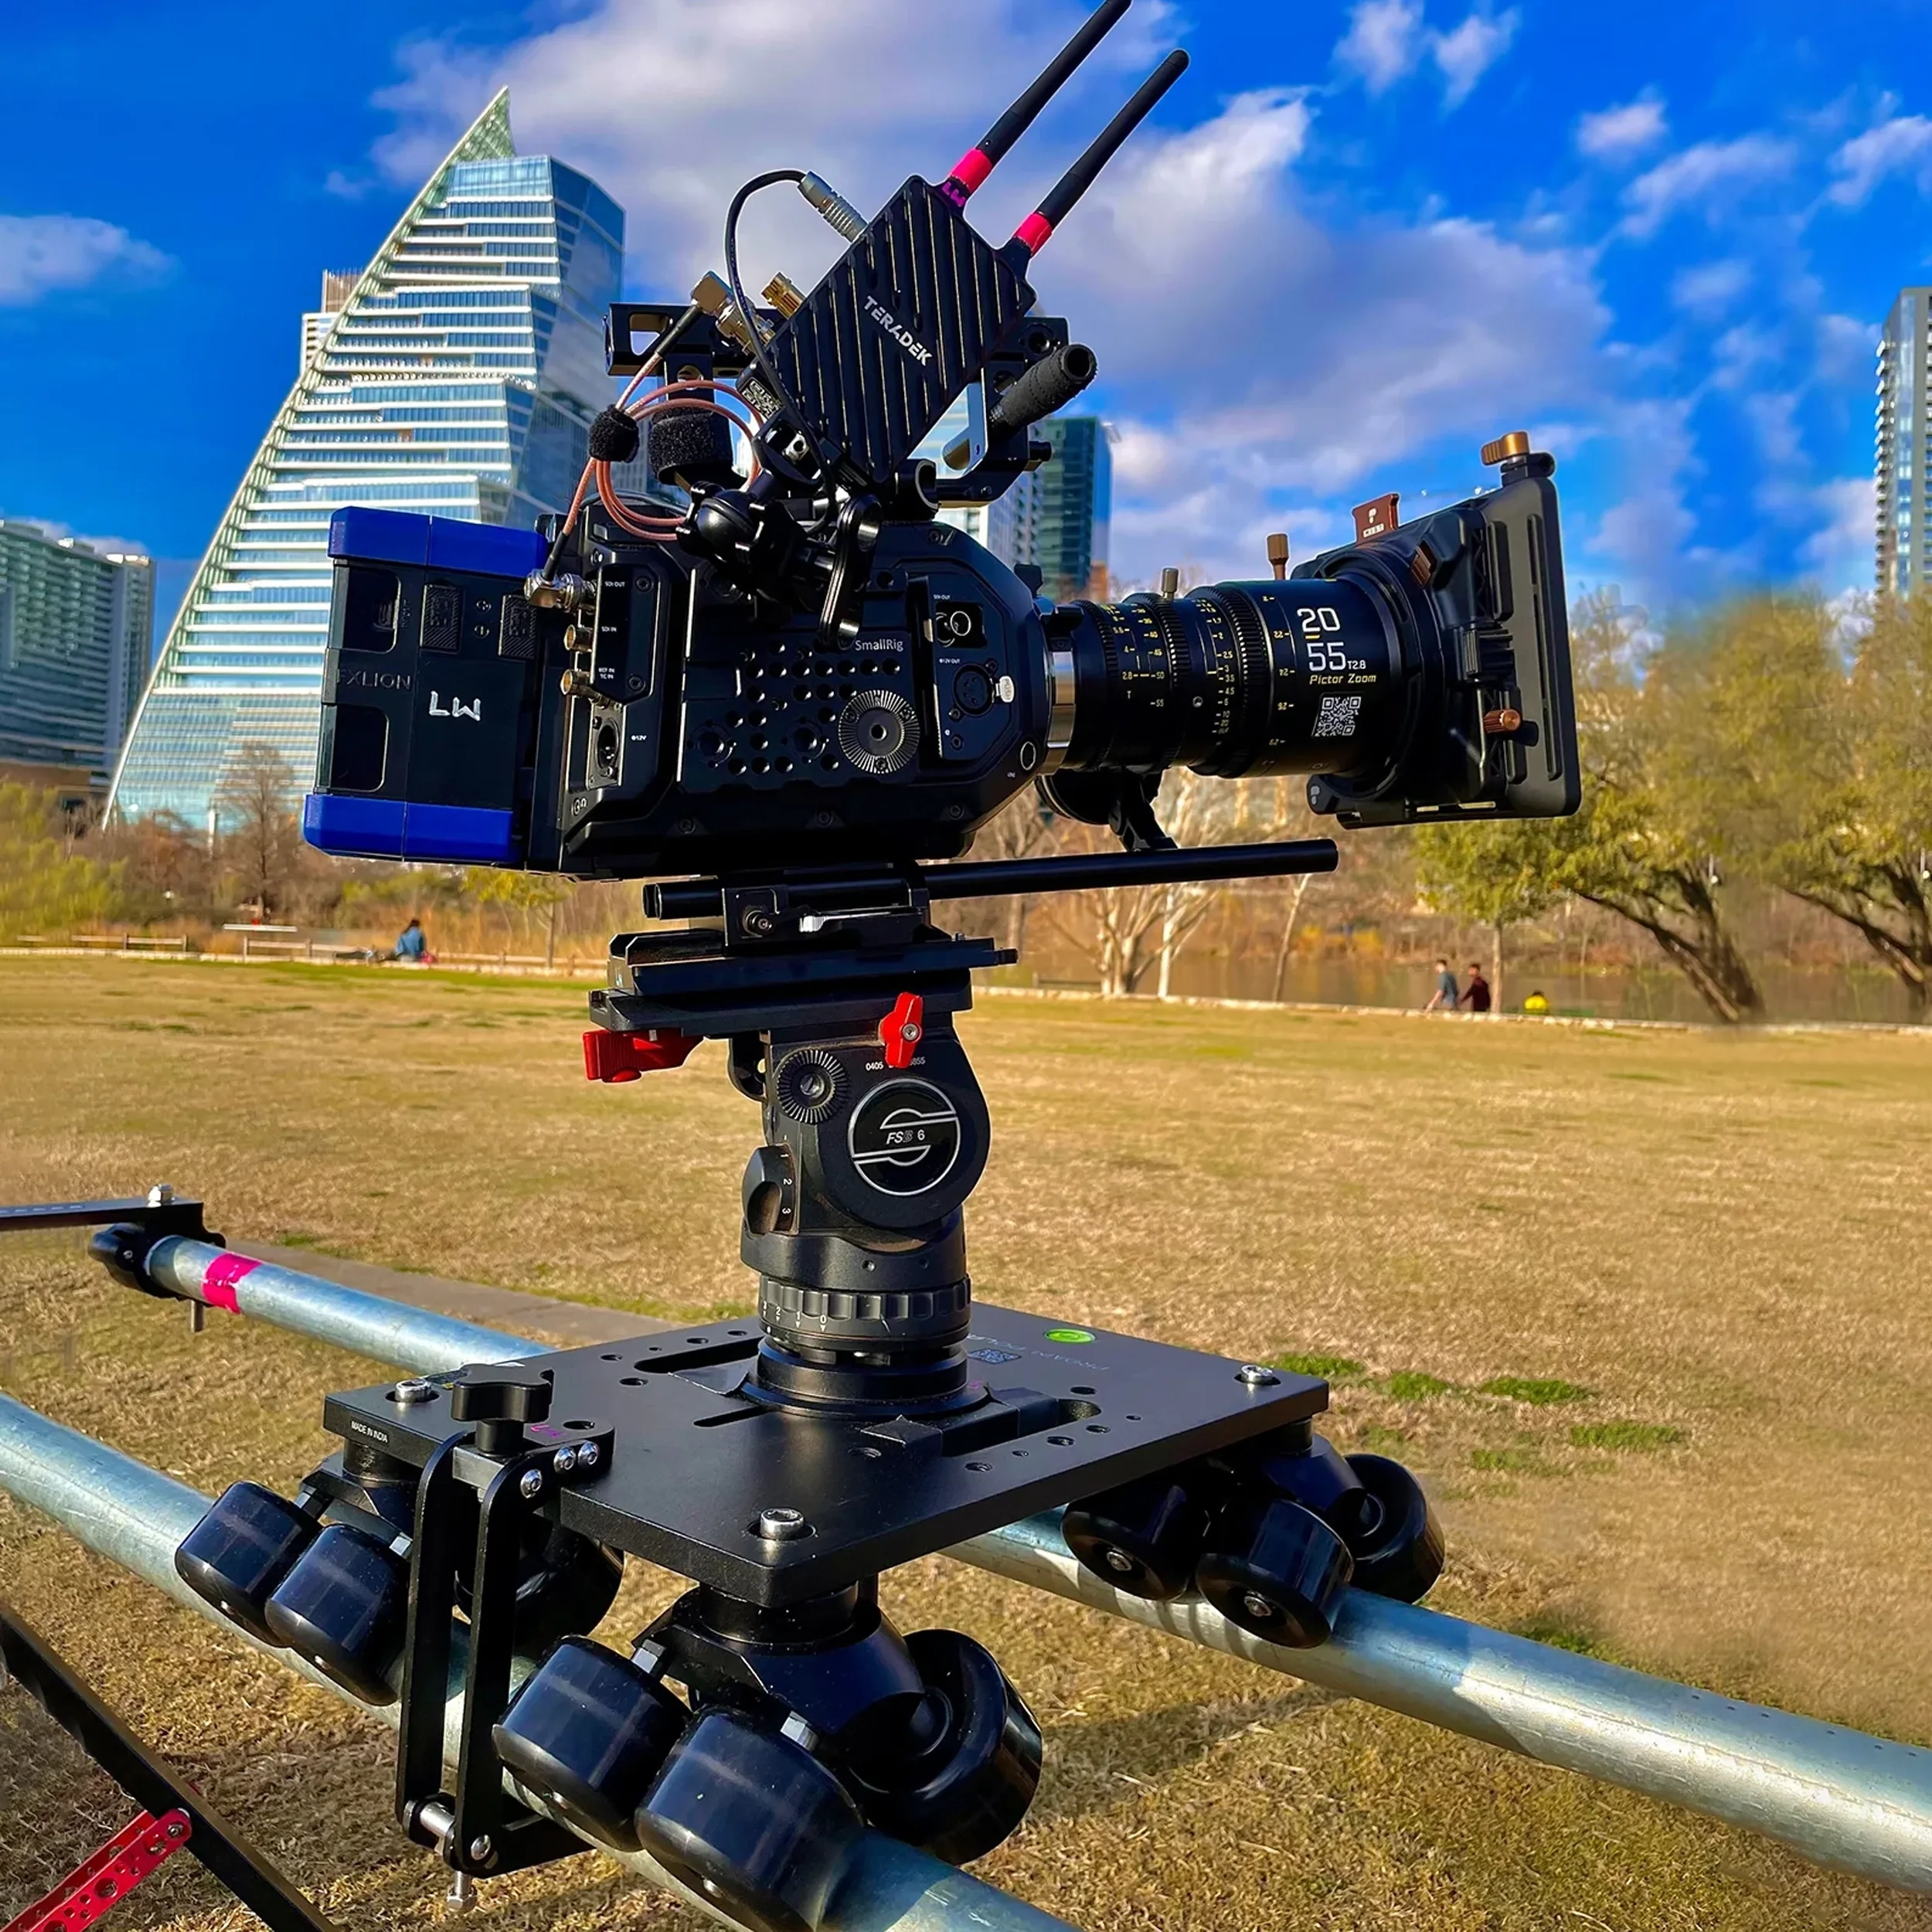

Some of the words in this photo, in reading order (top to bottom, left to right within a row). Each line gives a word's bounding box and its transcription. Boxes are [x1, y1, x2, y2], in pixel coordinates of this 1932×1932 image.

[863, 295, 933, 366] TERADEK
[1297, 607, 1341, 632] 20
[855, 638, 903, 652] SmallRig
[1307, 641, 1346, 672] 55
[1347, 660, 1366, 670] T2.8
[1122, 672, 1132, 680] 2.8
[1309, 674, 1344, 685] Pictor
[1348, 673, 1377, 684] Zoom
[1127, 690, 1131, 699] T
[429, 690, 481, 721] LW
[917, 1129, 925, 1141] 6
[776, 1306, 781, 1315] 2
[796, 1311, 801, 1320] 1
[820, 1315, 827, 1324] 0
[351, 1420, 367, 1434] MADE
[367, 1427, 373, 1437] IN
[373, 1430, 388, 1443] INDIA
